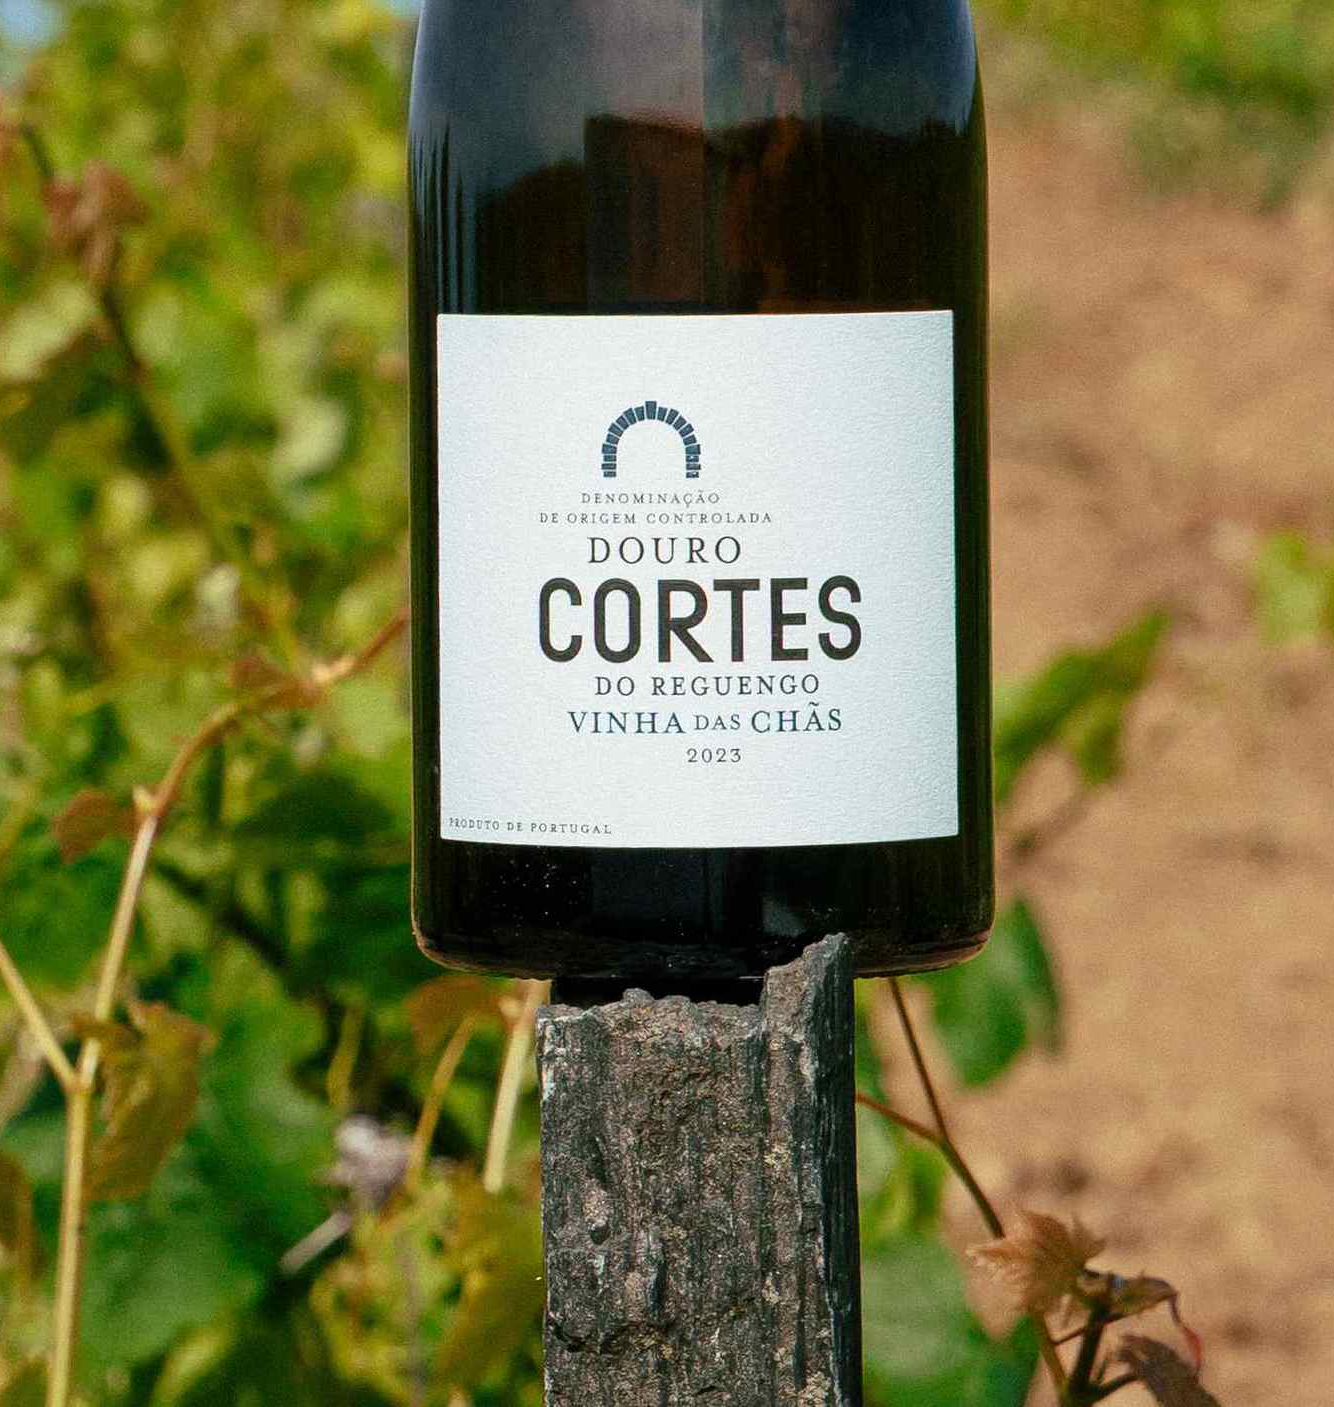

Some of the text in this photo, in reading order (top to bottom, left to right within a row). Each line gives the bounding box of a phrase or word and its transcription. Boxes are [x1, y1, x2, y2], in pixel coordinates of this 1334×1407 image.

[581, 490, 721, 508] DENOMINAÇÃO
[539, 513, 773, 524] DE ORIGEM CONTROLADA
[588, 536, 741, 564] DOURO
[538, 574, 862, 663] CORTES
[594, 673, 819, 697] DO REGUENGO
[567, 702, 843, 734] VINHA DAS CHÃS
[687, 748, 742, 763] 2023
[507, 822, 524, 832] DE
[530, 823, 612, 835] PORTUGAL
